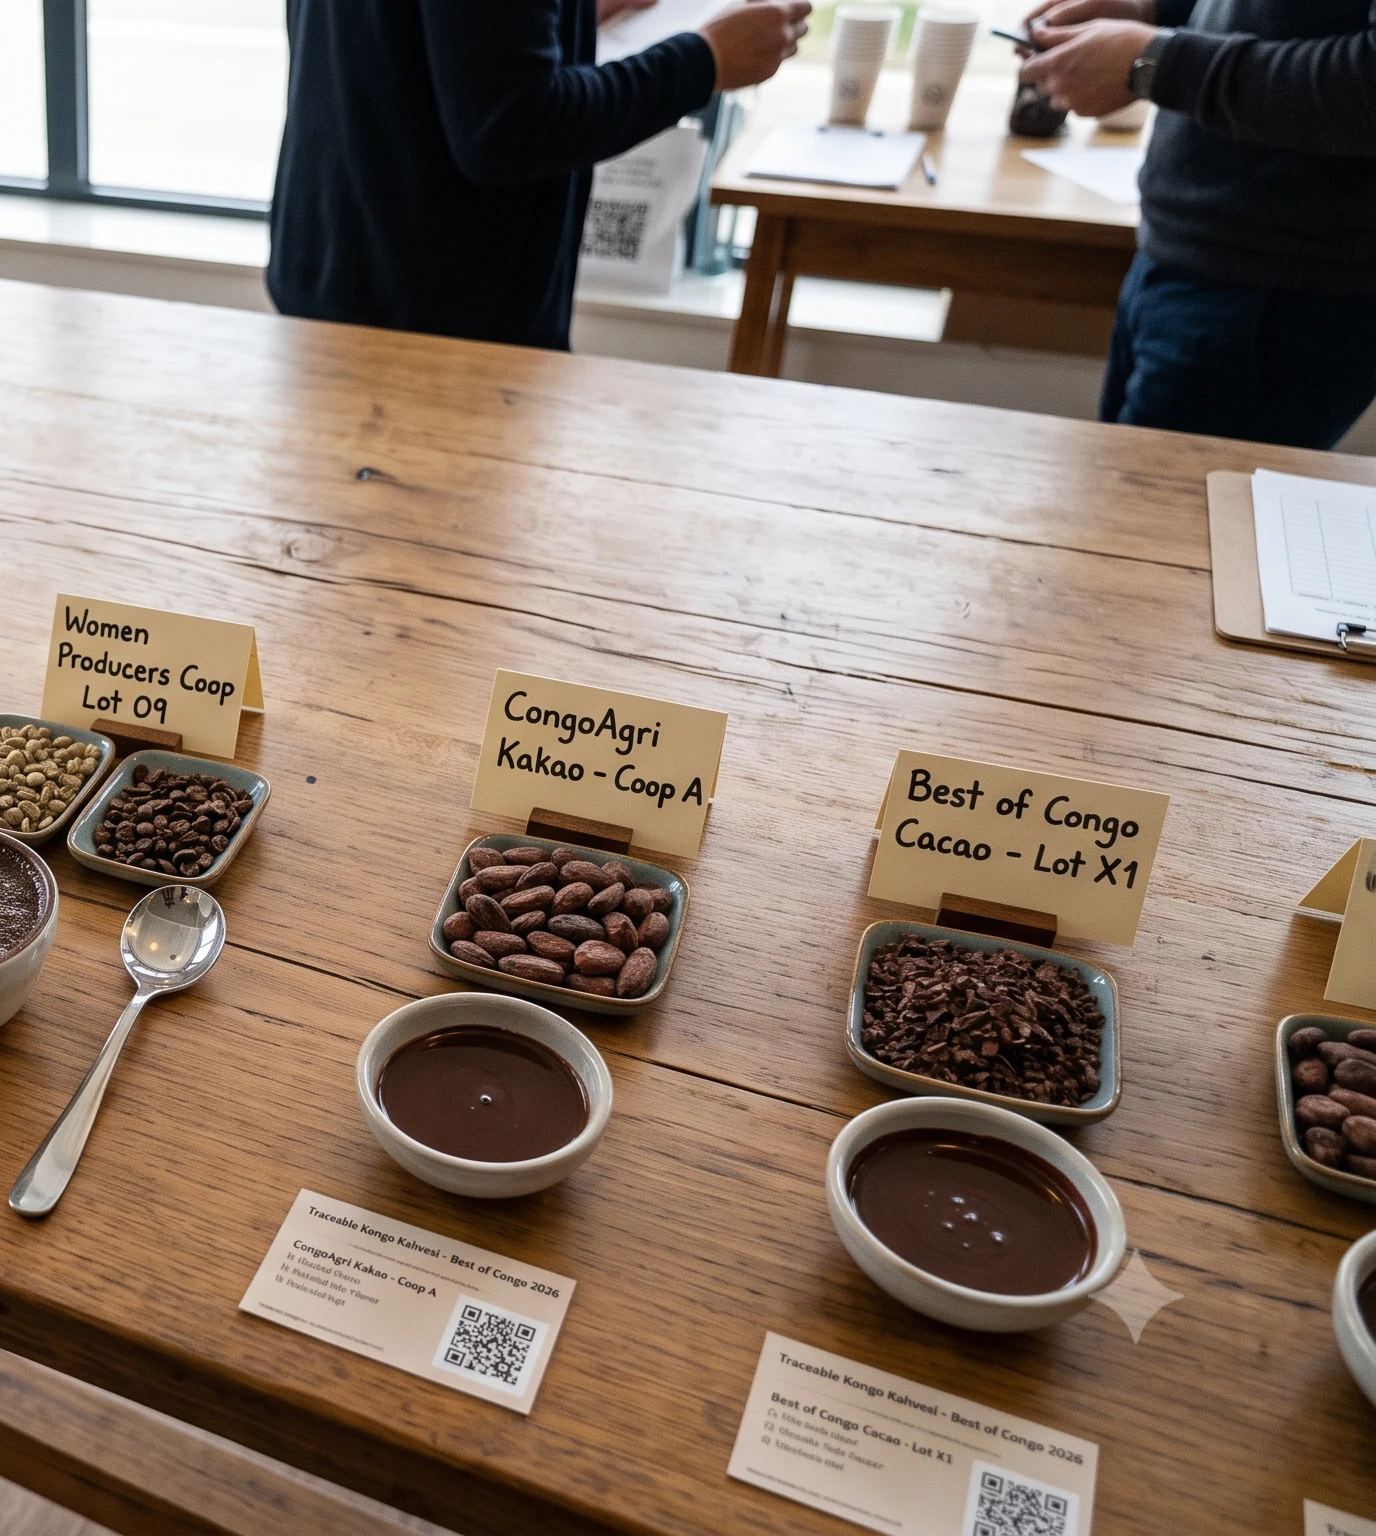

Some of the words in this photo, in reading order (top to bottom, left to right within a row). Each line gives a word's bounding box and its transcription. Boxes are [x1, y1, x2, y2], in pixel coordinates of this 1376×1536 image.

[65, 605, 149, 646] Women
[57, 641, 171, 686] Producers
[179, 664, 235, 707] Coop
[82, 684, 123, 715] Lot
[133, 695, 168, 725] 09
[504, 690, 662, 756] CongoAgri
[496, 736, 585, 782] Kakao
[614, 764, 676, 809] Coop
[681, 776, 703, 807] A
[907, 768, 985, 811] Best
[995, 788, 1034, 820] of
[1043, 795, 1140, 850] Congo
[895, 817, 992, 861] Cacao
[1033, 843, 1087, 879] Lot
[1093, 854, 1139, 890] X1
[293, 1239, 353, 1267] CongoAgri
[353, 1260, 388, 1280] Kakao
[397, 1276, 426, 1295] Coop
[427, 1287, 437, 1298] A
[309, 1205, 359, 1231] Traceable
[360, 1223, 395, 1243] Kongo
[396, 1236, 441, 1259] Kahvesi
[449, 1254, 476, 1271] Best
[477, 1265, 493, 1275] of
[492, 1268, 528, 1288] Congo
[770, 1391, 800, 1411] Best
[802, 1405, 818, 1416] of
[819, 1409, 860, 1432] Congo
[862, 1424, 902, 1447] Cacao
[911, 1441, 934, 1458] Lot
[936, 1450, 952, 1465] X1
[779, 1352, 841, 1382] Traceable
[842, 1374, 885, 1398] Kongo
[887, 1390, 939, 1416] Kahvesi
[950, 1411, 981, 1431] Best
[983, 1425, 999, 1436] of
[1000, 1428, 1045, 1452] Congo
[1047, 1444, 1084, 1466] 2026
